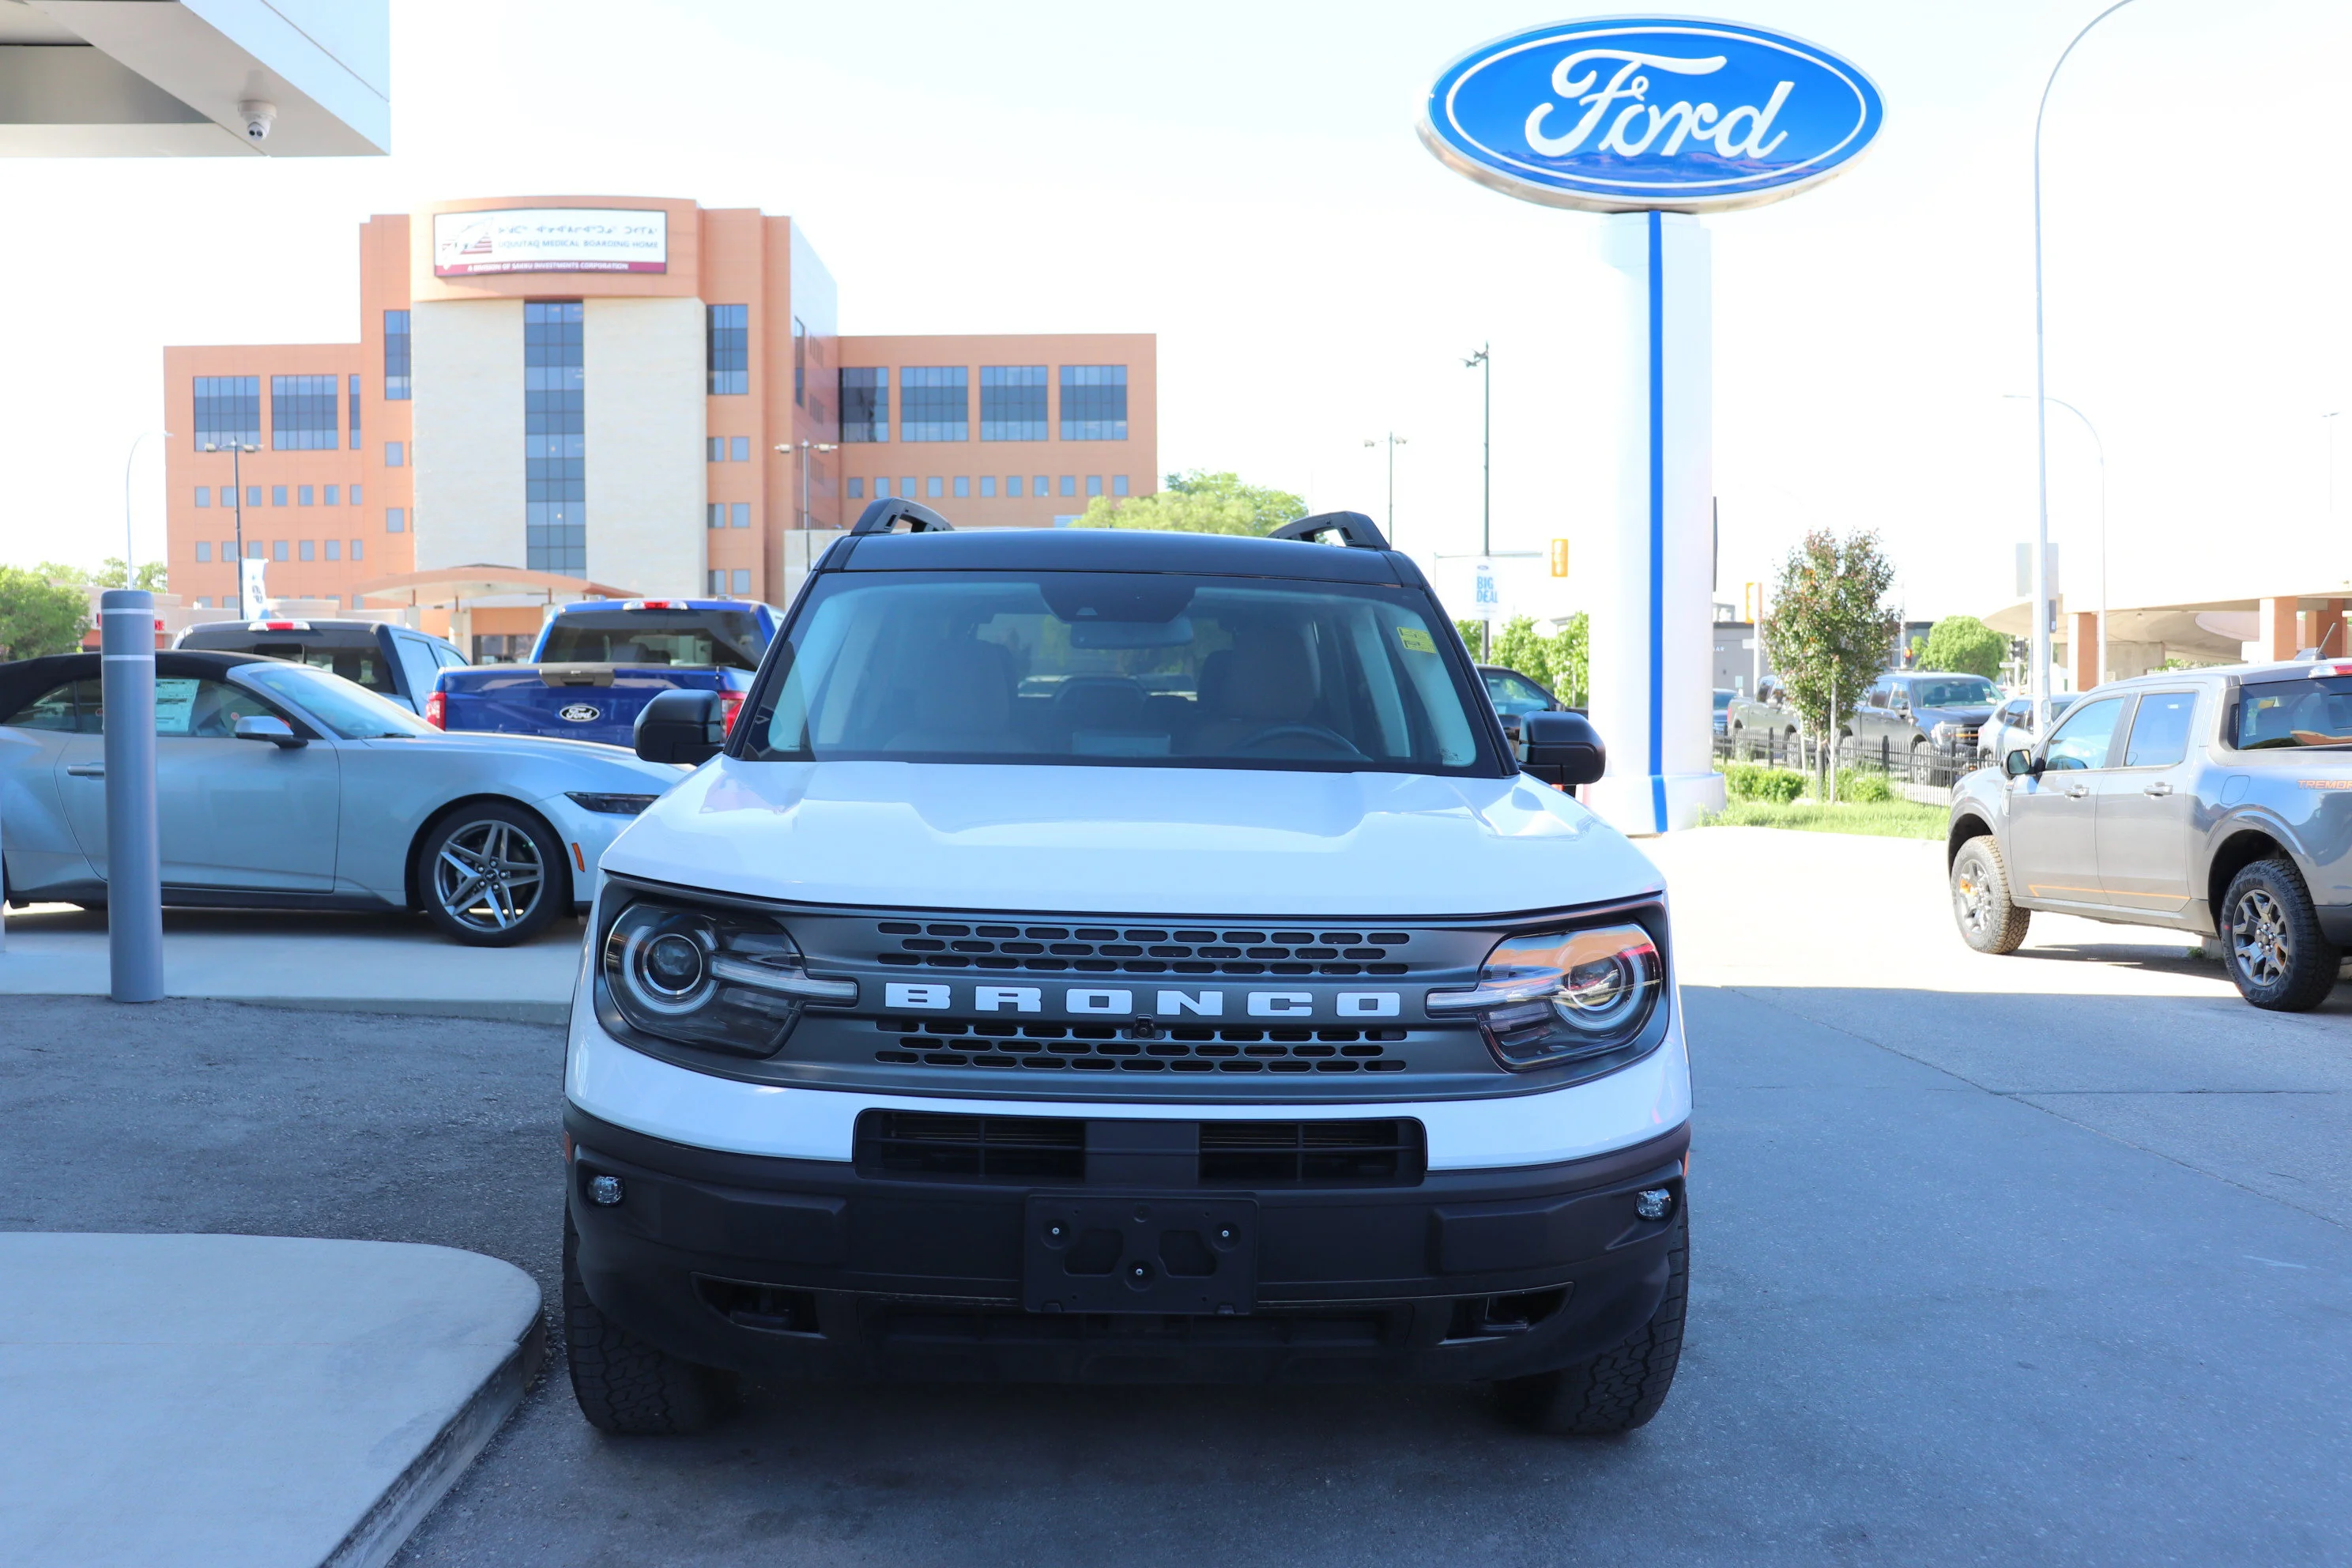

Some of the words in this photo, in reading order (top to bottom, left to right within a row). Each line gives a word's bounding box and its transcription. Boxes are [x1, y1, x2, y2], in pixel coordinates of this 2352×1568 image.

[1525, 49, 1796, 159] Ford
[1476, 575, 1494, 590] BIG
[1476, 590, 1498, 604] DEAL
[566, 707, 593, 719] Ford
[885, 982, 1400, 1017] BRONCO
